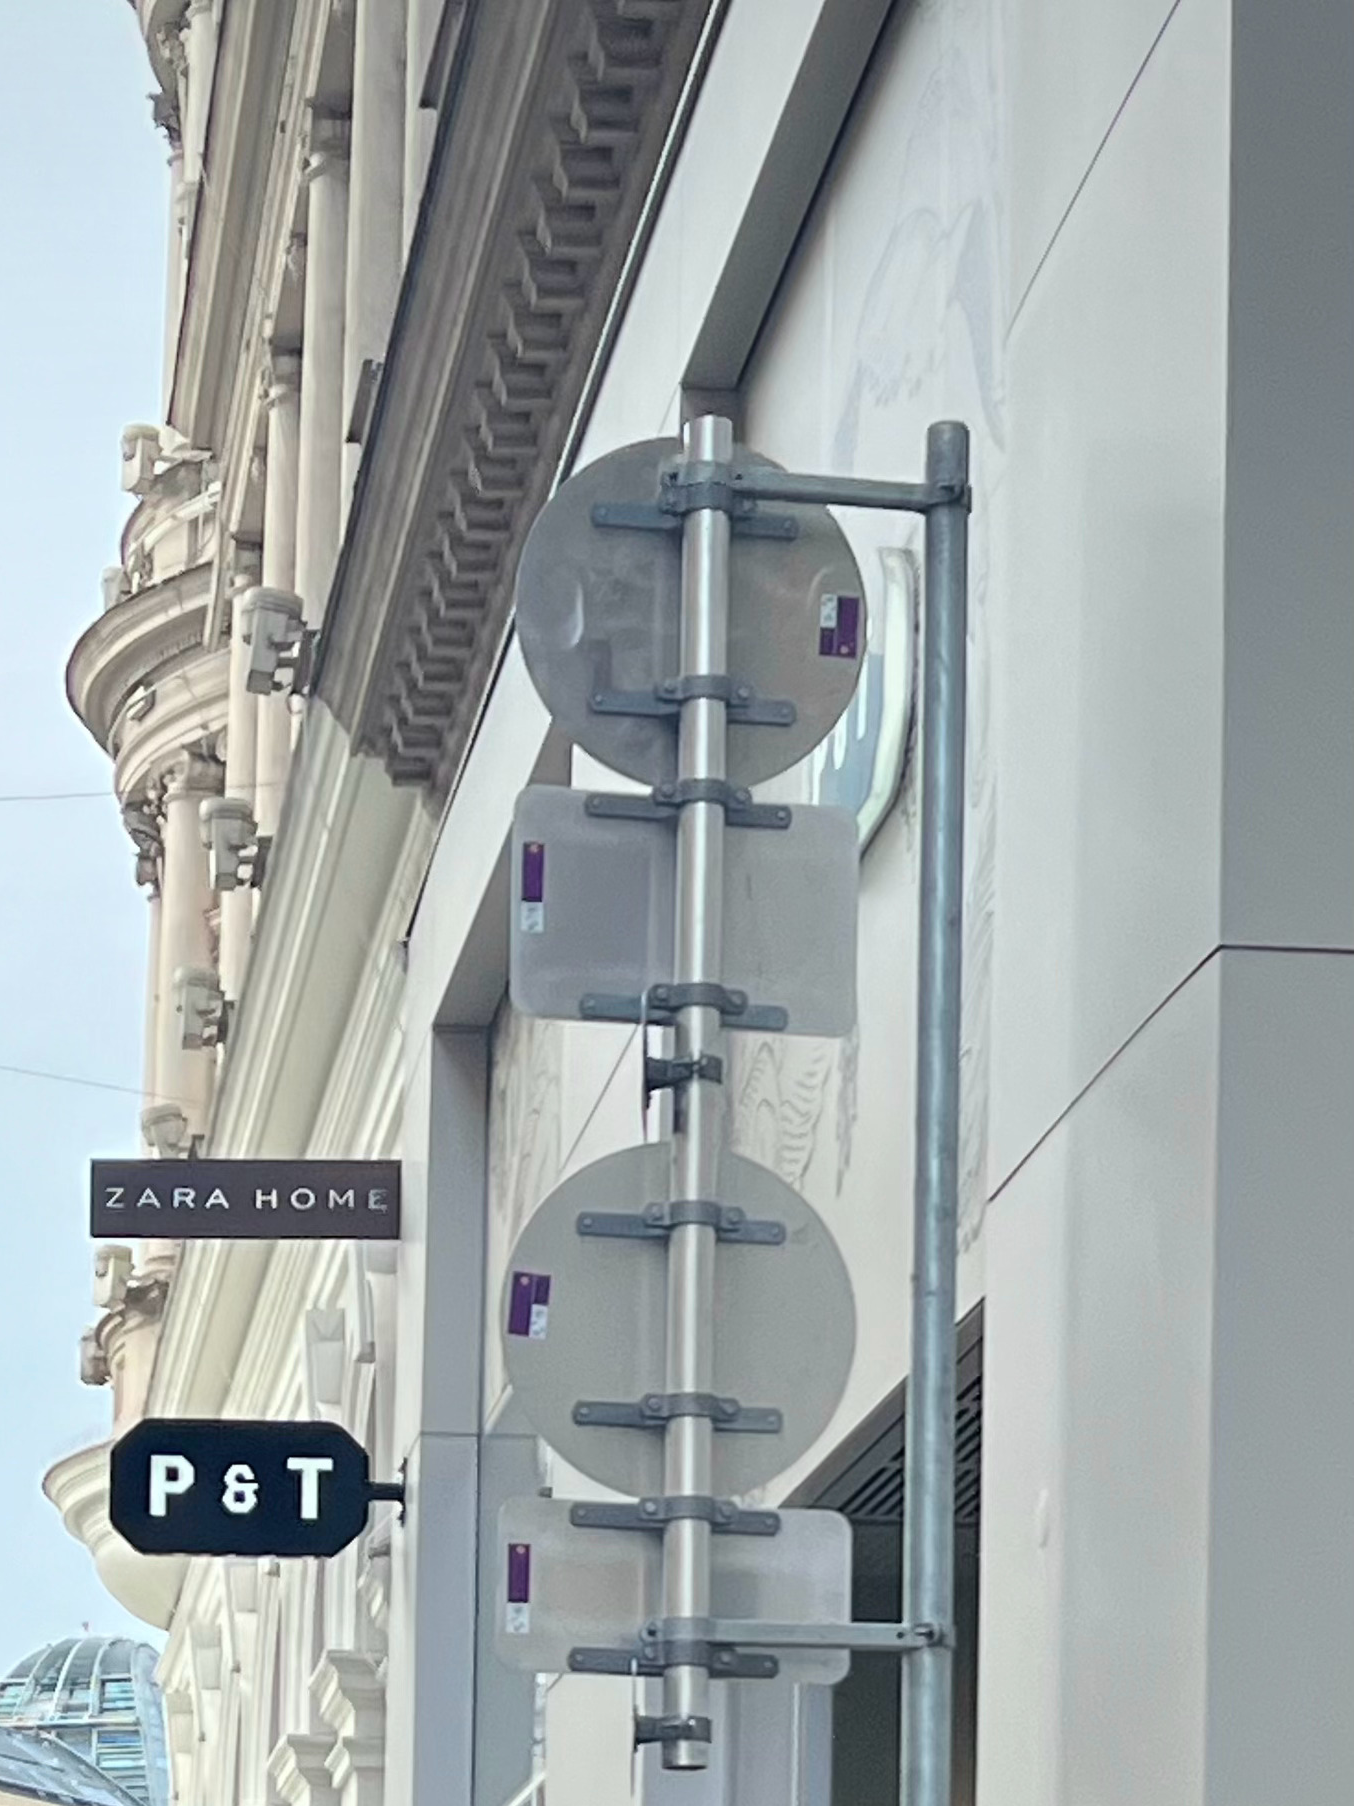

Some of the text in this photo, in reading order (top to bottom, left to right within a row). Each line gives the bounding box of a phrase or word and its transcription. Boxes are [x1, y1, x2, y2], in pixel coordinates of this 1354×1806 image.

[104, 1187, 389, 1212] ZARA HOME
[148, 1454, 335, 1519] P & T
